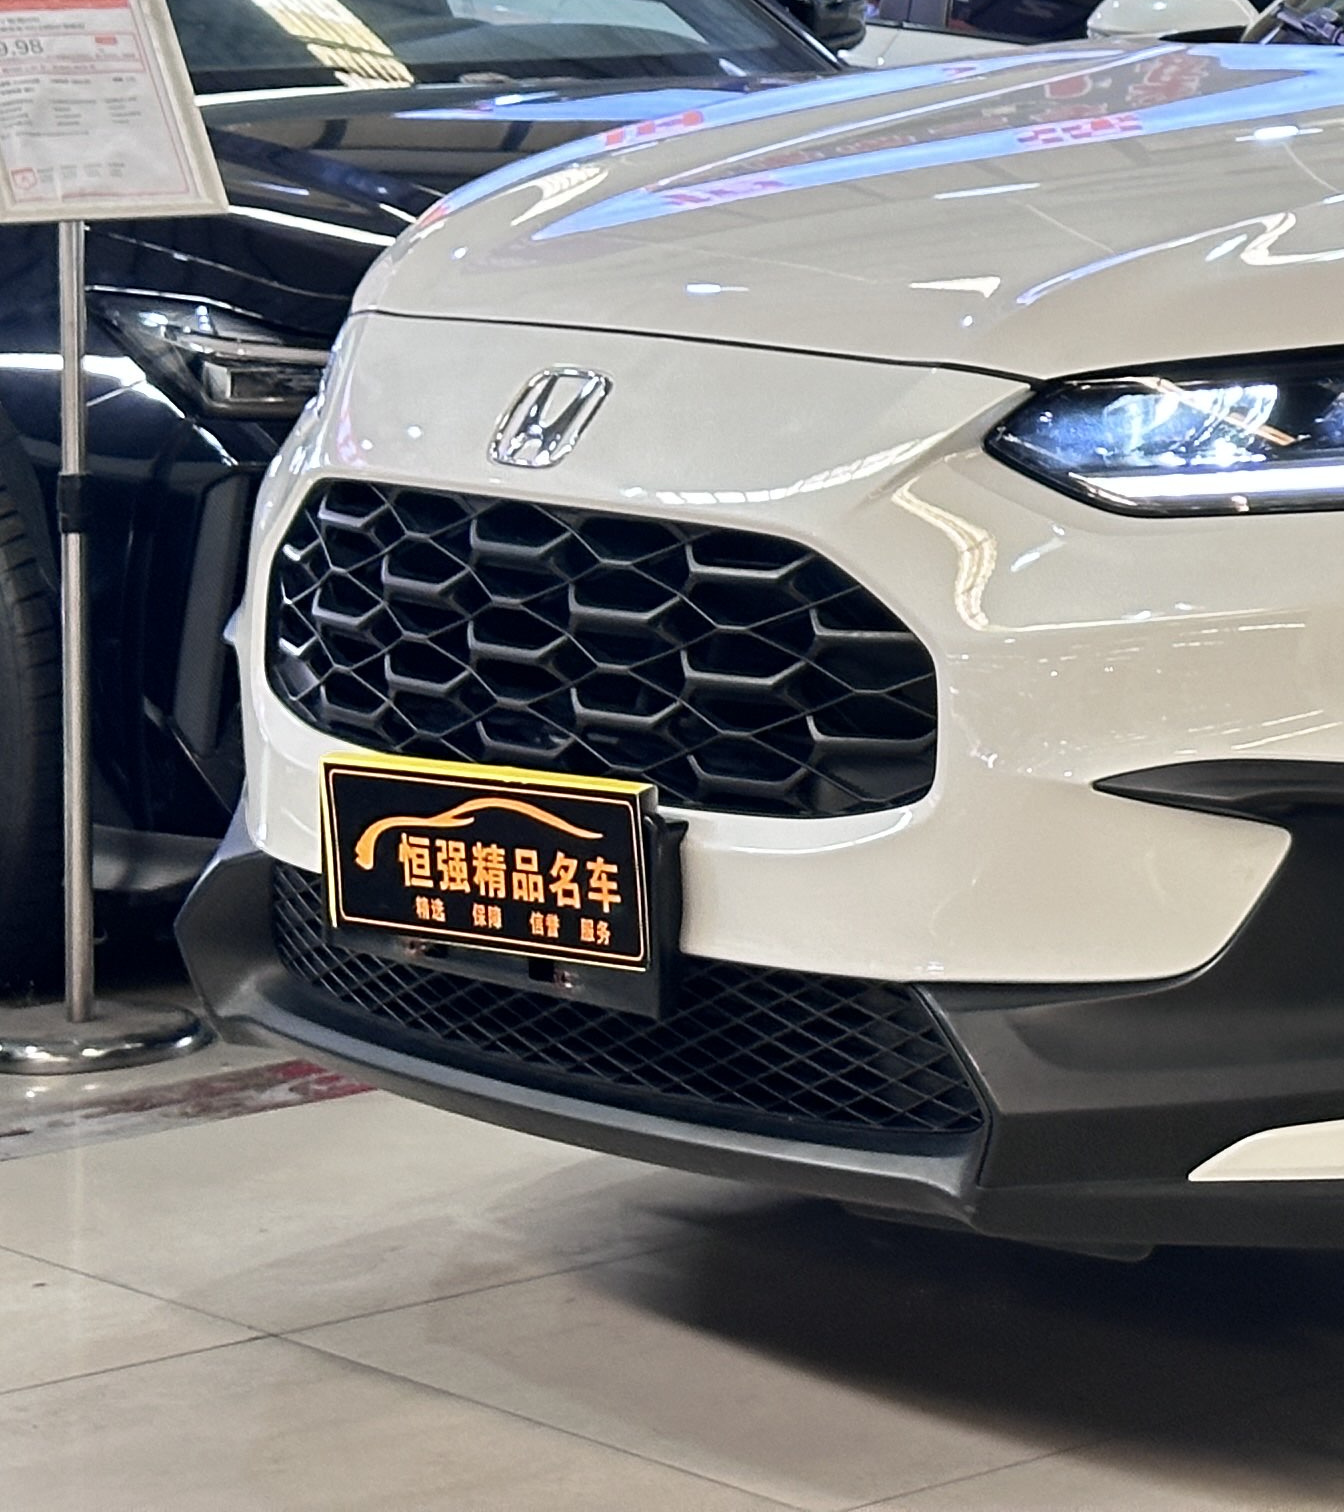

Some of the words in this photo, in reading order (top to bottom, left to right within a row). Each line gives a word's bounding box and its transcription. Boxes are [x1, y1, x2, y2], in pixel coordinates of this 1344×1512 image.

[398, 832, 622, 914] 恒强精品名车
[415, 895, 446, 923] 精选
[472, 902, 503, 930] 保障
[529, 910, 560, 939] 信誉
[580, 917, 611, 946] 服务
